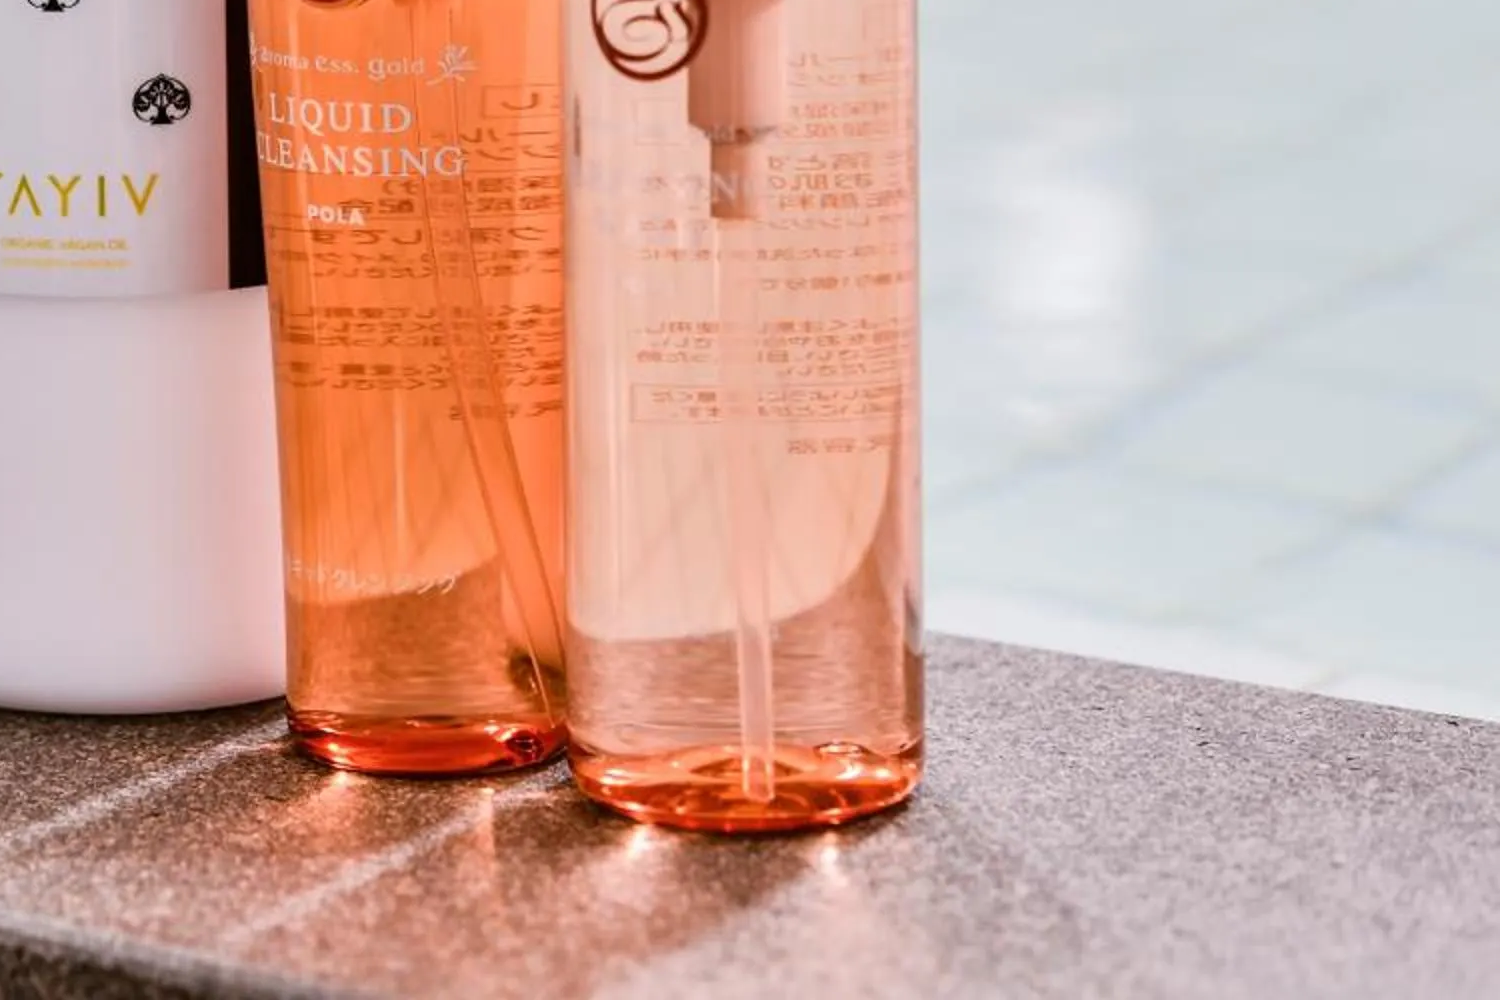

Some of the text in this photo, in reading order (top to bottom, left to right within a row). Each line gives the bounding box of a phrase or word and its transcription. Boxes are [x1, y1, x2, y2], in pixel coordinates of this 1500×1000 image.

[368, 56, 426, 82] gold
[269, 91, 413, 137] LIQUID
[306, 203, 366, 226] POLA
